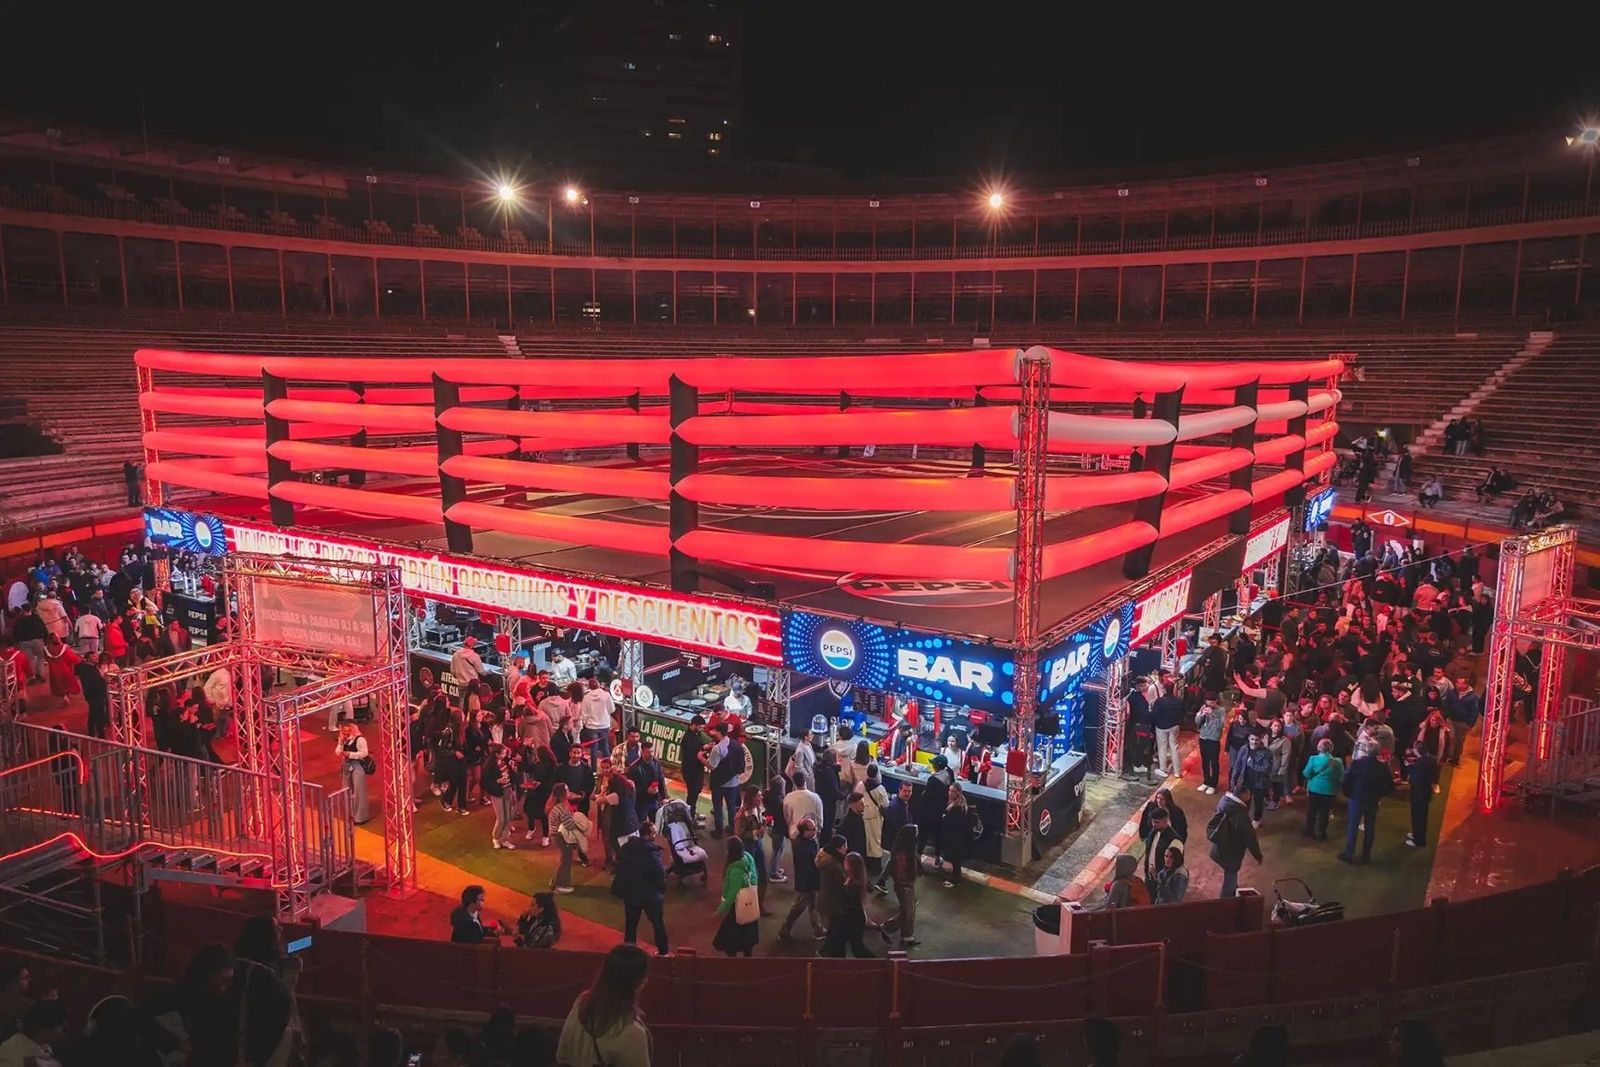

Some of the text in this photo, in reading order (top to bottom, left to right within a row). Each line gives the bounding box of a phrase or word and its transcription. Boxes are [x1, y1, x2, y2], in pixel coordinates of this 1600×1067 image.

[851, 580, 1010, 592] PEPSI
[397, 555, 453, 594] OBTÉN
[459, 567, 570, 616] OBSEQUIOS
[575, 586, 590, 619] Y
[597, 591, 759, 652] DESCUENTOS
[823, 643, 853, 656] PEPSI
[898, 648, 994, 693] BAR
[1050, 642, 1090, 693] BAR
[641, 720, 650, 733] LA
[651, 720, 674, 741] ÚNICA
